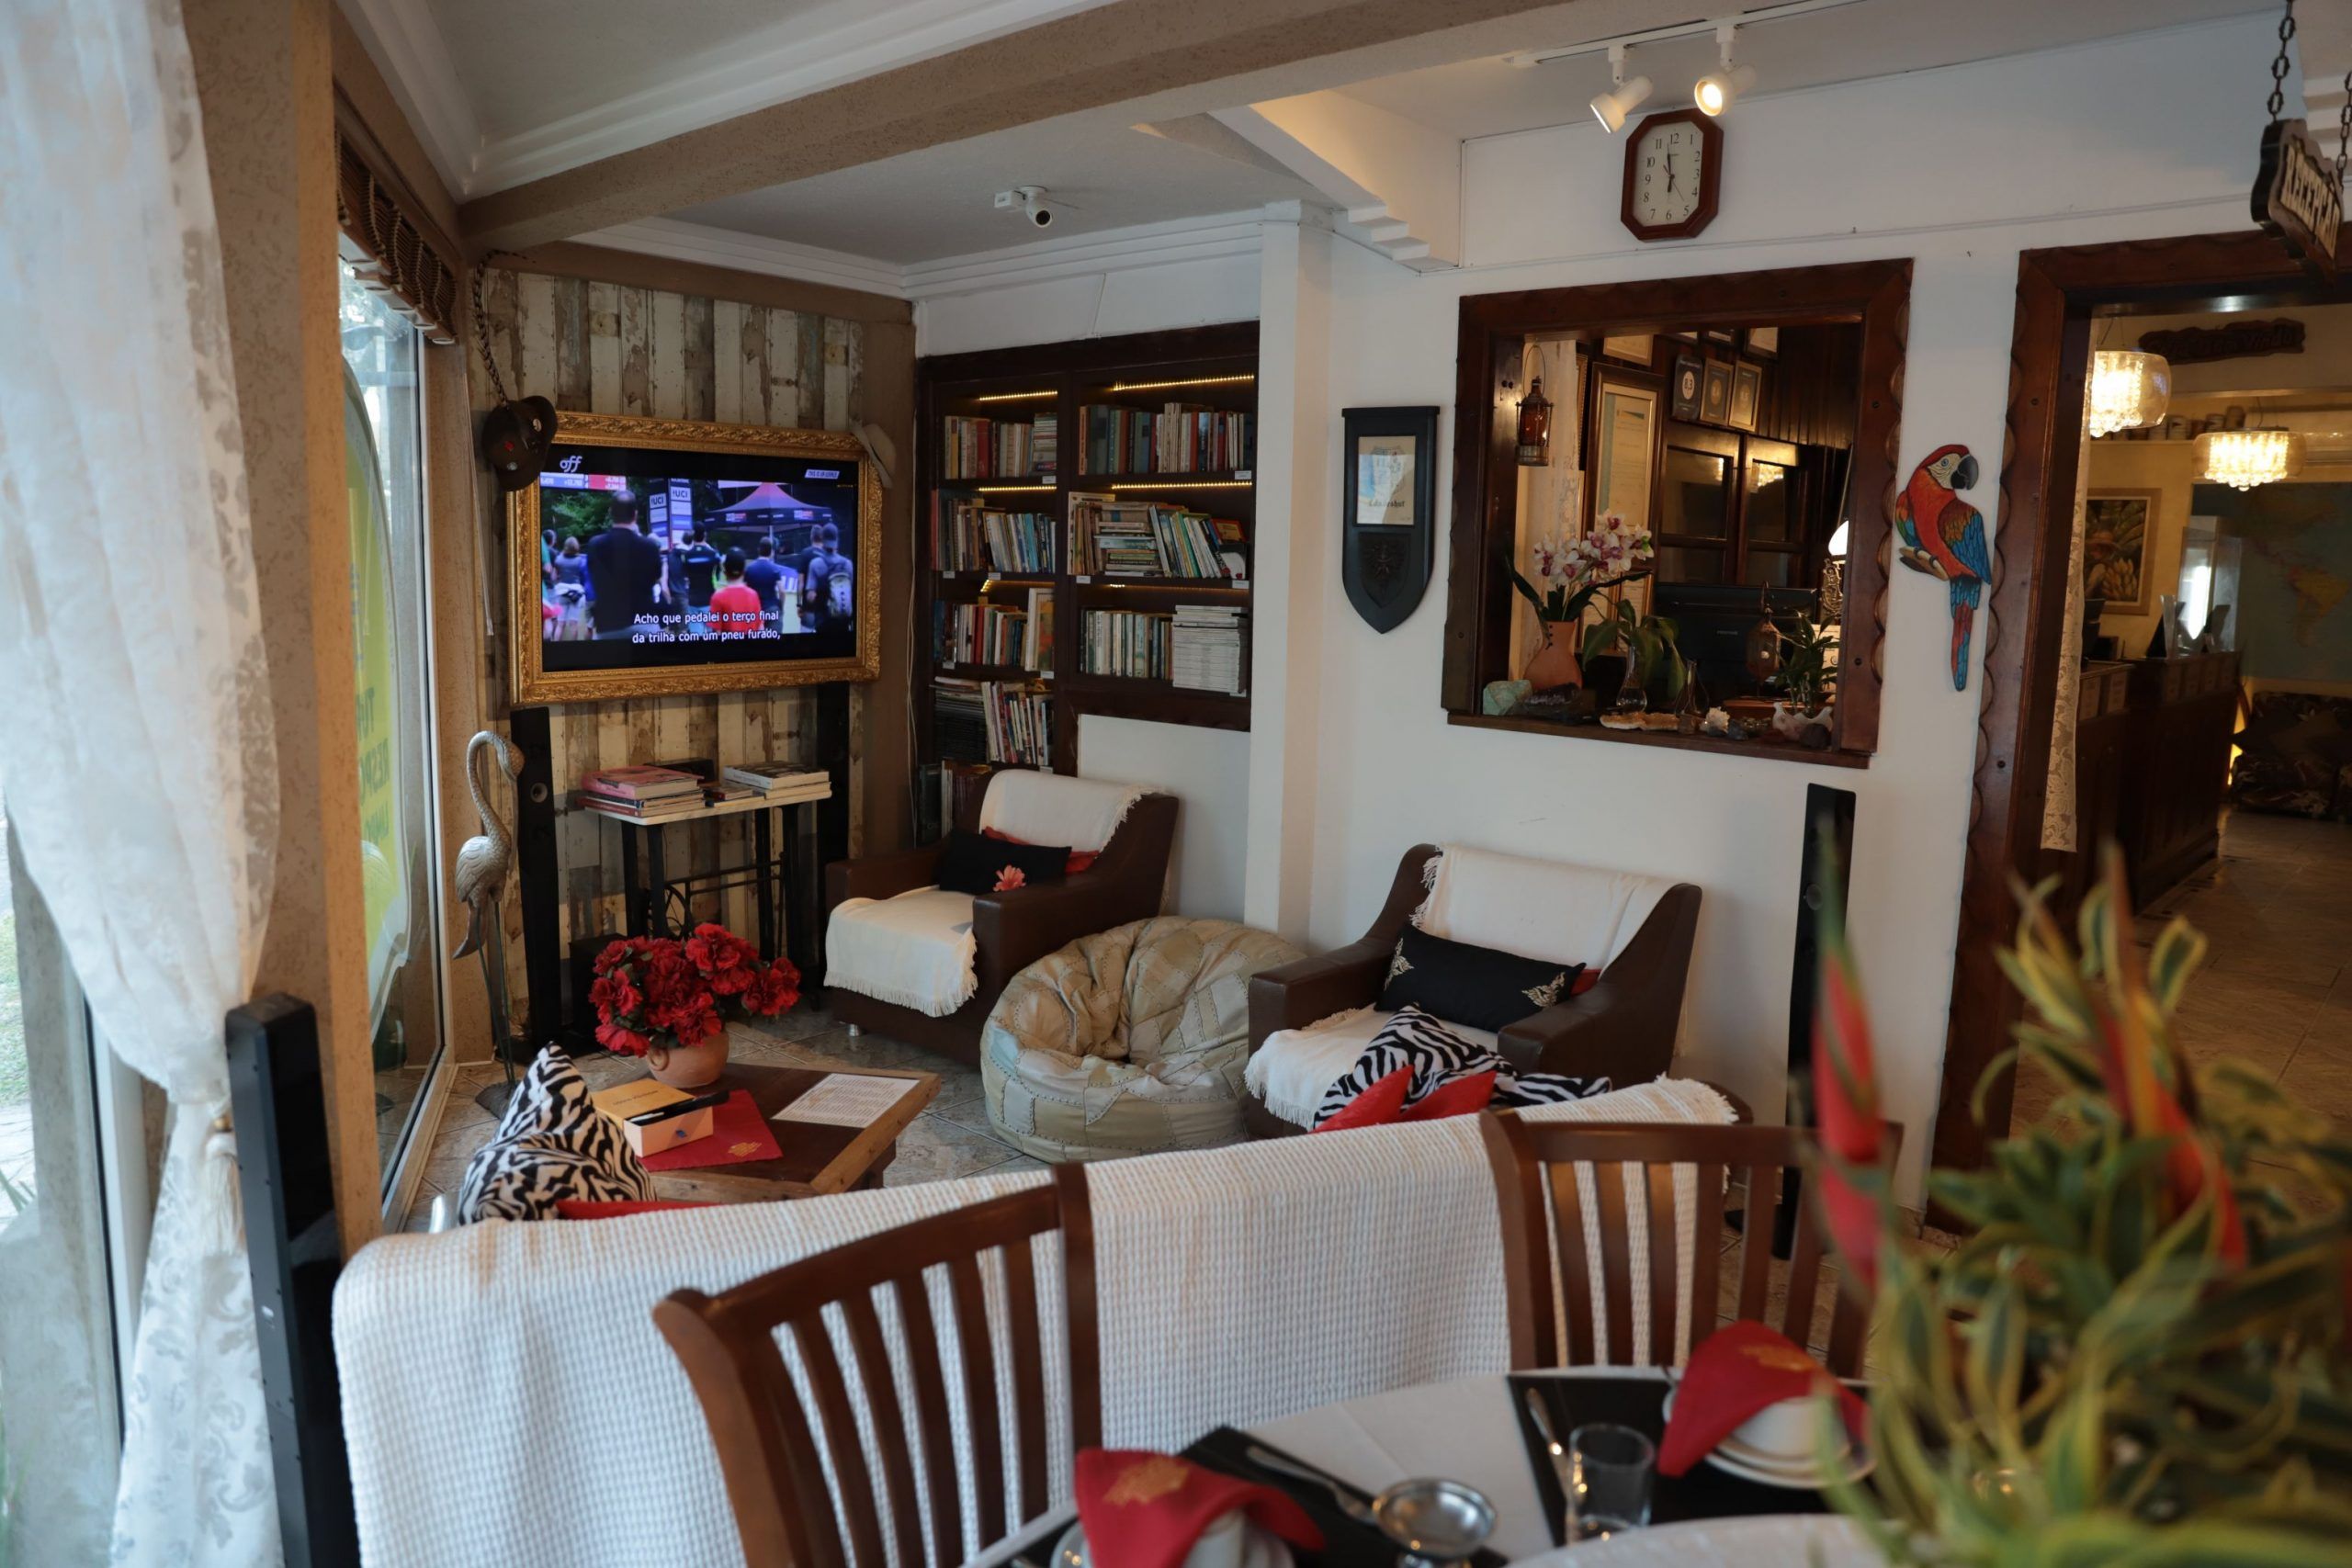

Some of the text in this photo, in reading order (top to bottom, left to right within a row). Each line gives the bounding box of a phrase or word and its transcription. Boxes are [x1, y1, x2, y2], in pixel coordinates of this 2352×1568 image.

[1655, 138, 1662, 150] 11
[1669, 132, 1679, 144] 12
[1646, 156, 1656, 168] 10
[1694, 151, 1701, 163] 2
[1645, 175, 1651, 185] 9
[1693, 168, 1700, 180] 3
[1643, 192, 1650, 203] 8
[1691, 186, 1698, 197] 4
[1649, 209, 1656, 220] 7
[1666, 209, 1672, 220] 6
[1683, 205, 1690, 217] 5
[560, 456, 582, 473] off
[634, 610, 779, 626] Acho que pedalei o terço final
[632, 629, 781, 644] da trilha com um pneu furado,
